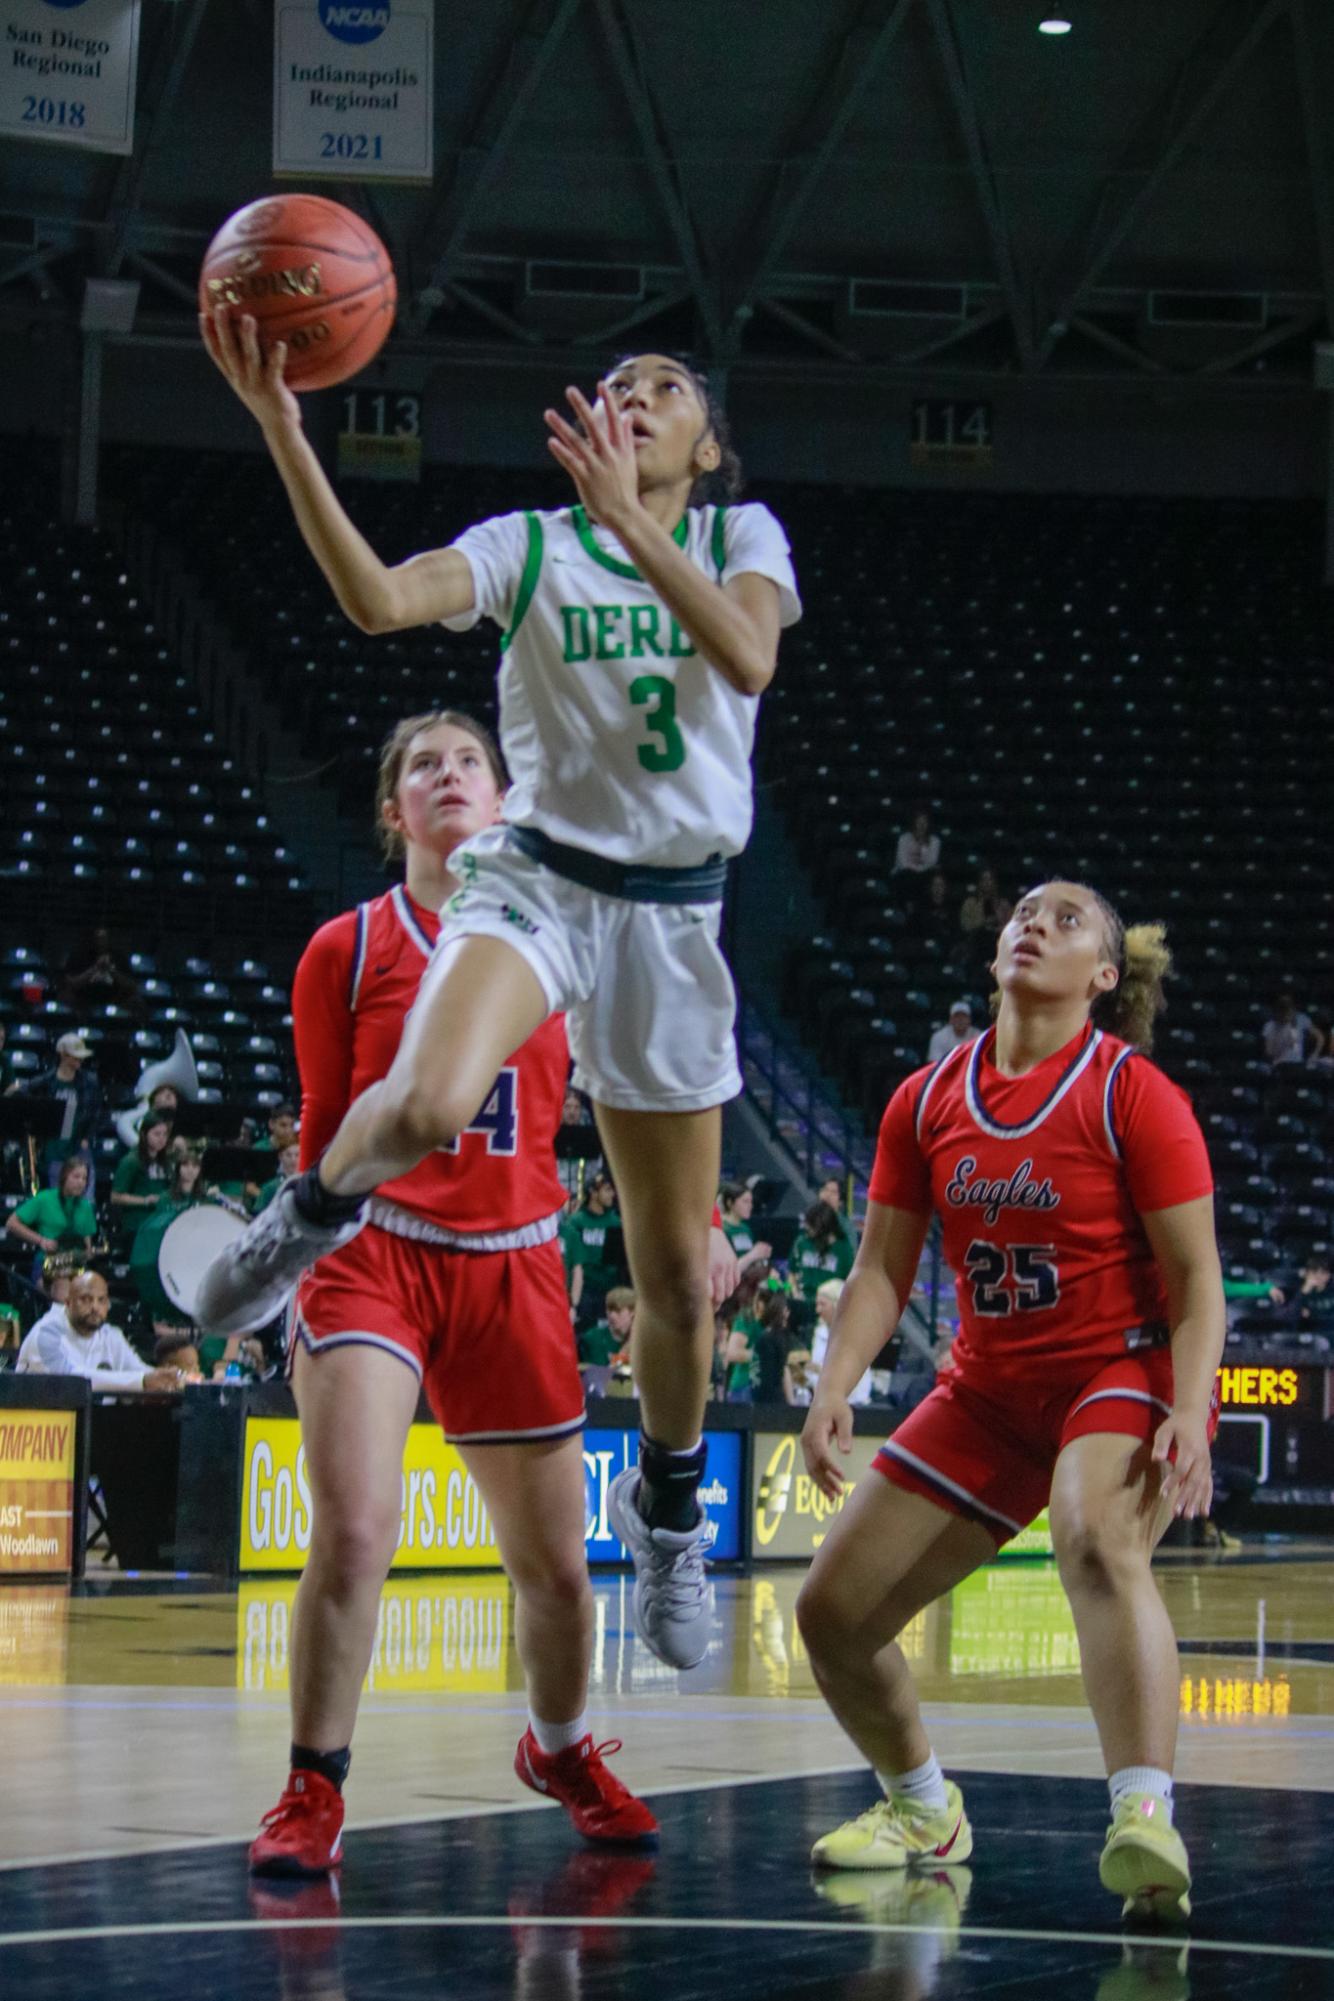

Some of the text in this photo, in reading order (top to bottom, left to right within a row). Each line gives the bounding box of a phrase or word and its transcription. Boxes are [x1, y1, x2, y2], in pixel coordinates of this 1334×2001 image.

[326, 6, 388, 28] NCAA
[6, 24, 110, 57] San Diego
[12, 49, 101, 79] Regional
[290, 64, 419, 90] Indianapolis
[21, 95, 86, 128] 2018
[310, 89, 400, 112] Regional
[320, 132, 383, 160] 2021
[344, 393, 419, 438] 113
[915, 403, 989, 448] 114
[629, 675, 687, 773] 3
[436, 1066, 519, 1157] 4
[946, 1155, 1061, 1227] Eagles
[964, 1238, 1061, 1318] 25
[1216, 1367, 1298, 1405] HERS
[0, 1423, 68, 1462] OMPANY
[0, 1505, 22, 1528] AST
